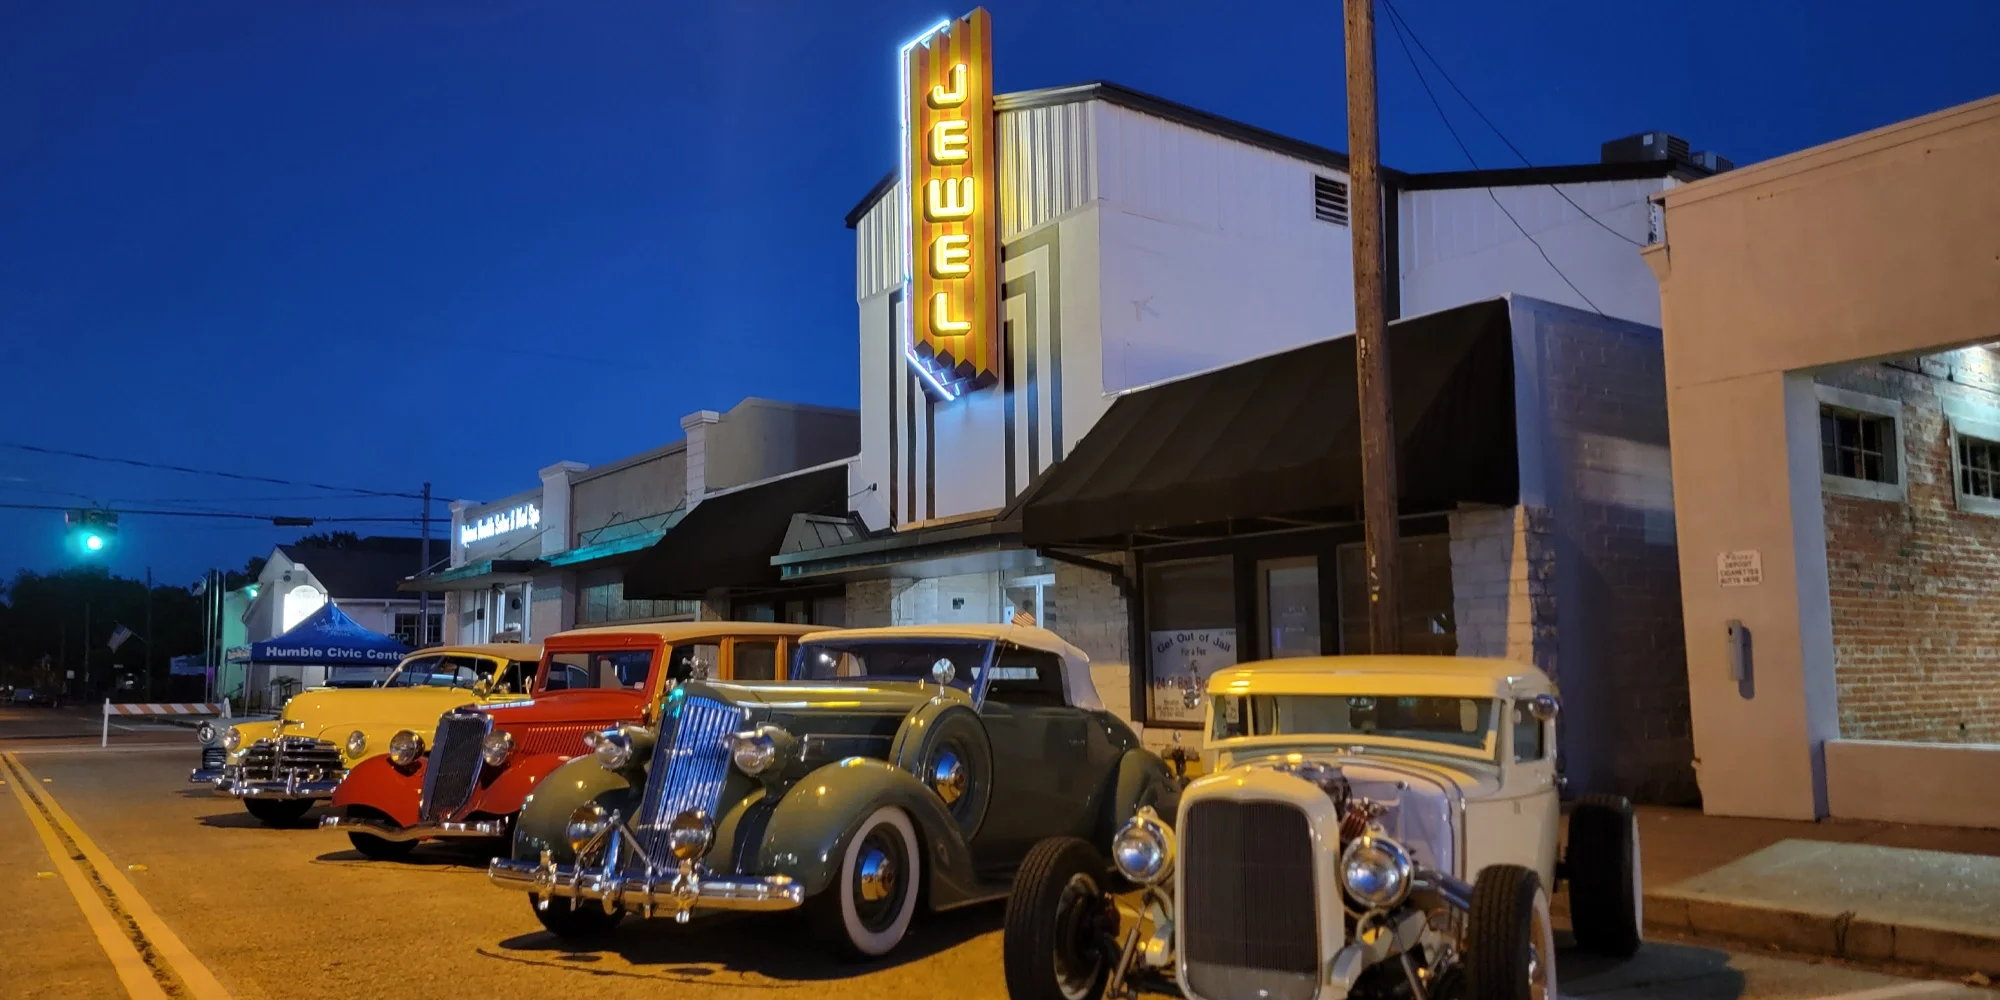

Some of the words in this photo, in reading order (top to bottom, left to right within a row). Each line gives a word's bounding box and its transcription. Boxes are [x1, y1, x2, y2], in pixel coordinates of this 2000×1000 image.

[926, 62, 975, 337] JEWEL
[1157, 638, 1173, 653] Get
[1177, 633, 1194, 642] Out
[1198, 634, 1209, 642] of
[1213, 638, 1231, 652] Jail
[1181, 647, 1189, 656] For
[1196, 647, 1207, 656] Fee
[266, 646, 323, 657] Humble
[327, 647, 362, 659] Civic
[366, 649, 406, 661] Cente
